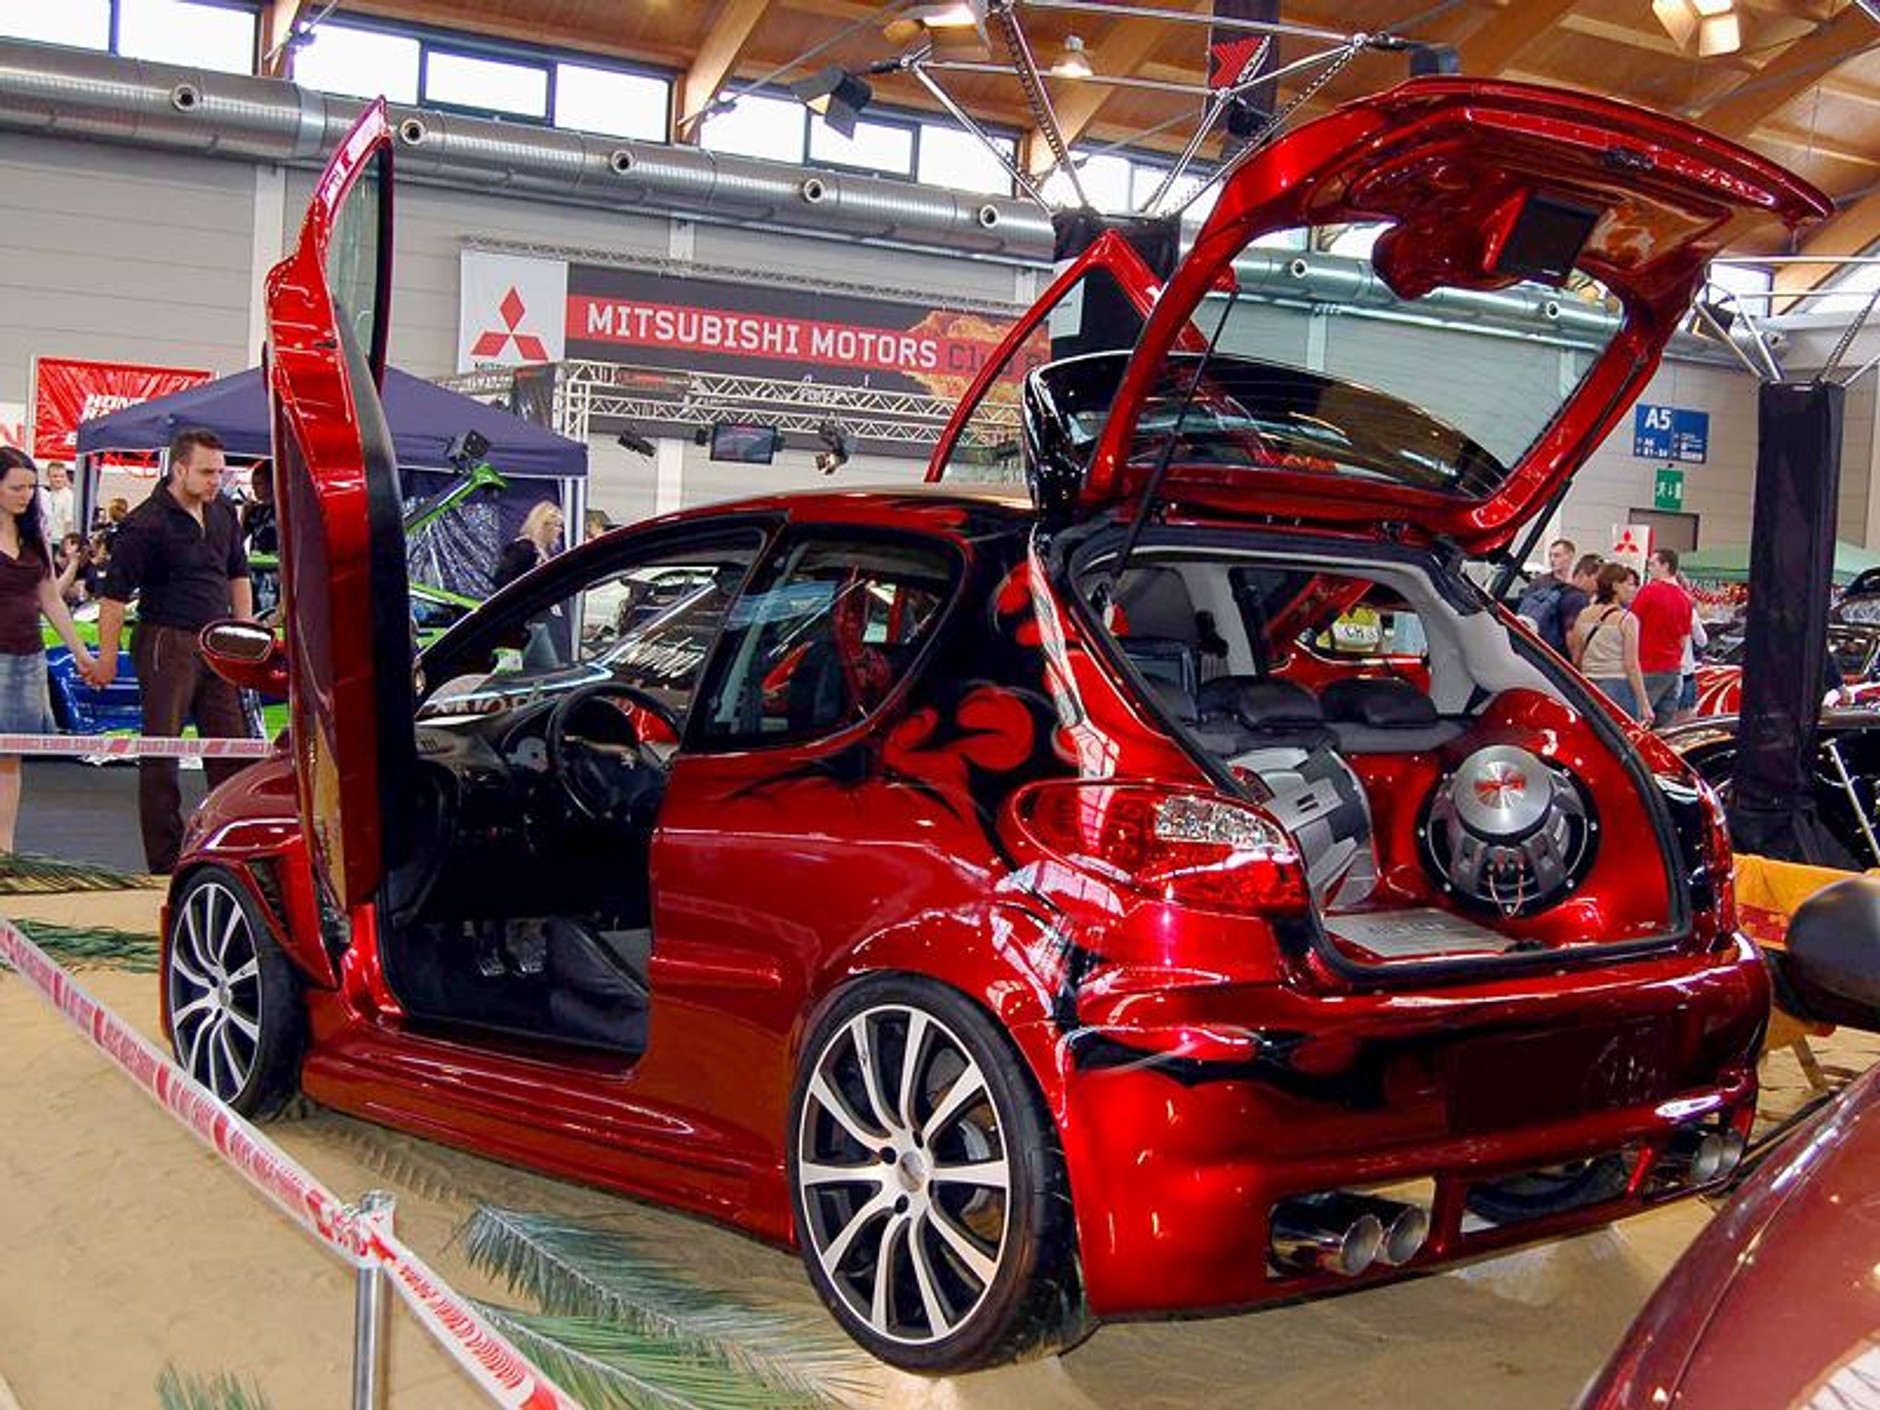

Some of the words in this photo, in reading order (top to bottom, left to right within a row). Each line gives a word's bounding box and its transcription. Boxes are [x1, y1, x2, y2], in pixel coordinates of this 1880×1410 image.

[587, 302, 800, 354] MITSUBISHI
[811, 327, 938, 369] MOTORS
[1644, 407, 1672, 431] A5
